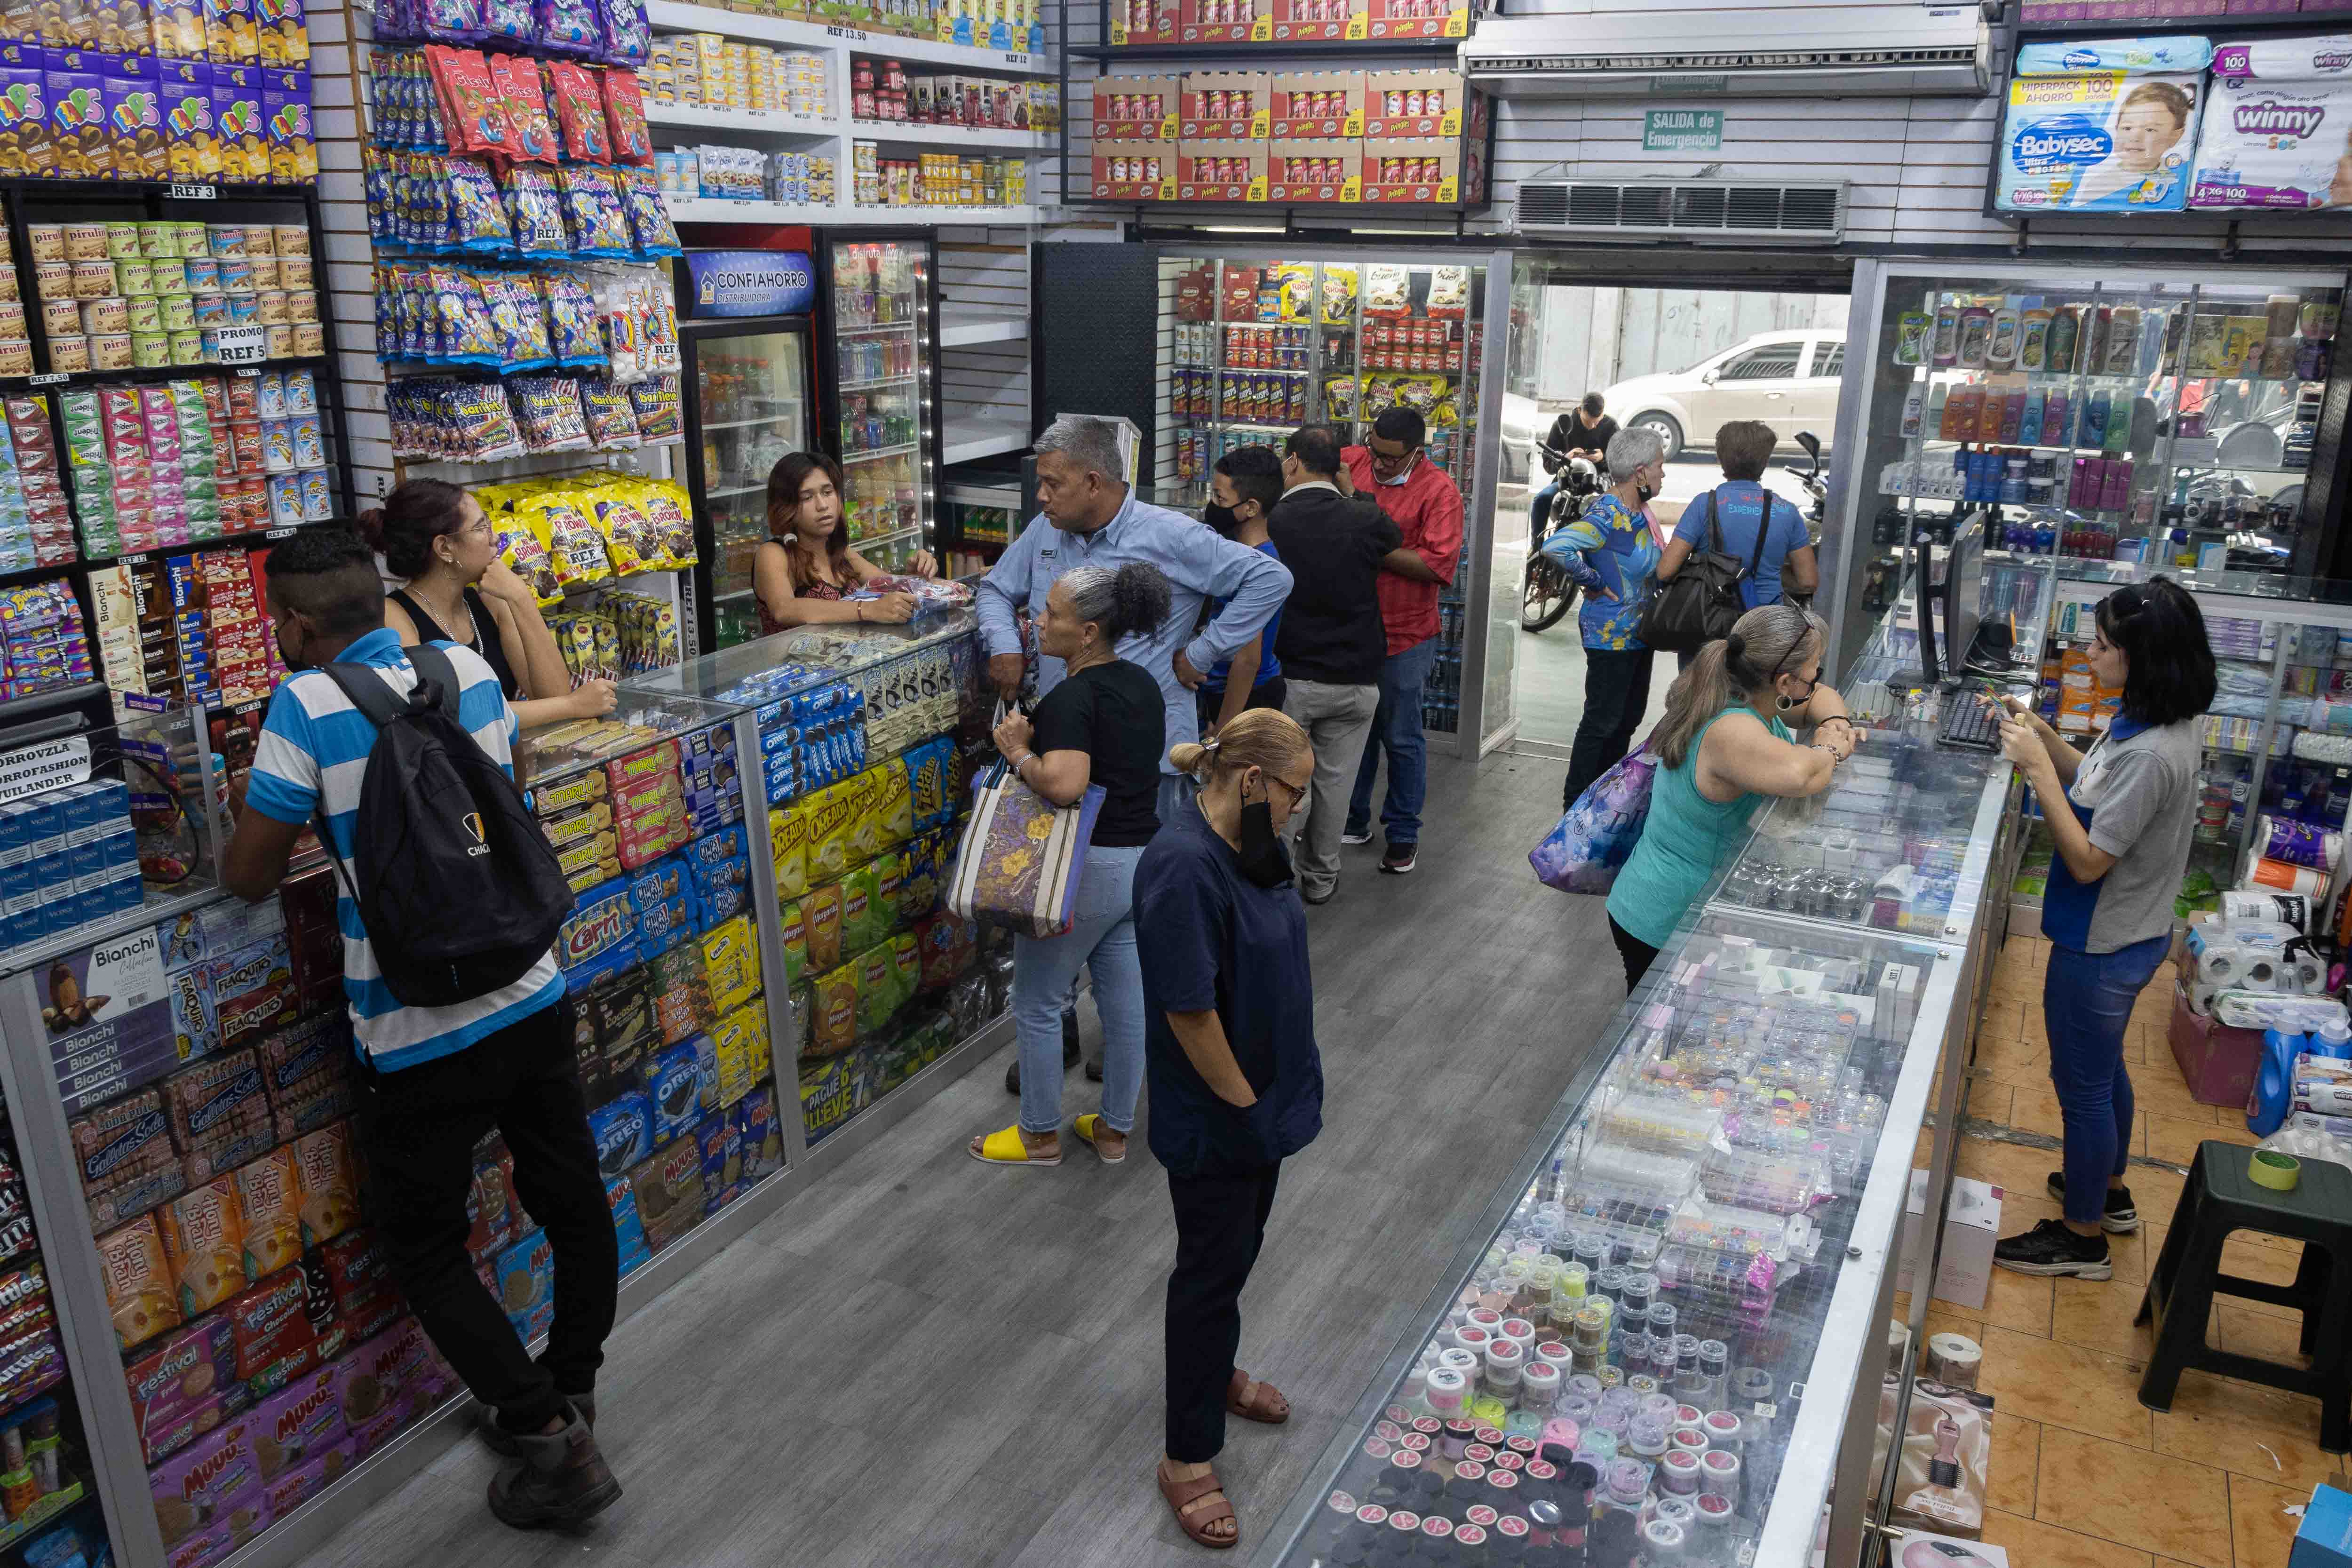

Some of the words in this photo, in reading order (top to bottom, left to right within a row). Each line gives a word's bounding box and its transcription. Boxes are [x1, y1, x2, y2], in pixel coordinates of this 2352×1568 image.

[827, 26, 843, 37] REF
[845, 29, 866, 41] 13.50
[1006, 54, 1018, 63] REF
[1020, 55, 1027, 64] 12
[2225, 56, 2246, 68] 100
[2022, 81, 2081, 92] HIPERPACK
[2086, 79, 2114, 94] 100
[2026, 92, 2074, 103] AHORRO
[386, 121, 396, 130] 50
[1653, 112, 1694, 128] SALIDA
[1700, 112, 1715, 128] de
[2237, 100, 2321, 136] winny
[1116, 122, 1134, 136] Pringles
[1204, 122, 1223, 136] Pringles
[1296, 121, 1315, 135] Pringles
[1390, 119, 1411, 135] Pringles
[1647, 132, 1717, 148] Emergencia
[2021, 135, 2106, 156] Babysec
[27, 142, 50, 155] CHOCOLATE
[87, 144, 110, 157] CHOCOLATE
[174, 187, 195, 197] REF
[205, 188, 214, 197] 3
[1116, 184, 1133, 198] Pringles
[1201, 184, 1220, 199] Pringles
[1293, 186, 1312, 199] Pringles
[1388, 185, 1407, 199] Pringles
[2198, 188, 2206, 198] 4
[2226, 189, 2247, 199] 100
[69, 228, 106, 241] pirulin
[537, 229, 554, 239] REF
[558, 229, 563, 238] 2
[852, 247, 881, 259] disfruta
[153, 264, 184, 276] pirulin
[717, 272, 808, 288] CONFIAHORRO
[717, 293, 771, 303] DISTRIBUIDORA
[221, 327, 263, 339] PROMO
[220, 346, 254, 361] REF
[258, 345, 264, 358] 5
[655, 345, 675, 354] REF
[175, 389, 199, 398] Trident
[110, 399, 134, 408] Trident
[180, 411, 203, 420] Trident
[113, 422, 136, 432] Trident
[613, 510, 642, 528] BROWN
[651, 509, 683, 525] BROWN
[515, 541, 545, 561] BROWN
[132, 574, 146, 616] Bianchi
[172, 567, 185, 607] Bianchi
[97, 581, 109, 623] Bianchi
[684, 587, 693, 614] REF
[104, 635, 124, 645] Bianchi
[142, 629, 161, 638] Bianchi
[108, 655, 128, 666] Bianchi
[111, 676, 131, 686] Bianchi
[237, 705, 250, 713] REF
[813, 696, 833, 710] OREO
[760, 707, 781, 722] OREO
[225, 726, 251, 738] TORONTO
[767, 733, 787, 749] OREO
[624, 753, 664, 776] MARILU
[771, 754, 791, 769] OREO
[811, 745, 821, 777] OREO
[820, 741, 831, 772] OREO
[773, 767, 794, 784] OREO
[550, 780, 594, 806] MARILU
[773, 782, 795, 800] OREO
[554, 812, 598, 840] MARILU
[633, 805, 672, 832] MARILU
[560, 841, 603, 868] MARILU
[569, 869, 603, 893] MARILU
[846, 894, 868, 912] Margarita
[813, 905, 839, 923] Margarita
[569, 912, 620, 956] Capri
[95, 935, 155, 967] Bianchi
[828, 1008, 852, 1024] Margarita
[66, 1023, 115, 1053] Bianchi
[70, 1041, 118, 1071] Bianchi
[74, 1060, 122, 1090] Bianchi
[659, 1063, 699, 1101] OREO
[79, 1078, 127, 1108] Bianchi
[809, 1073, 840, 1110] PAGUE
[189, 1090, 235, 1129] Galletas
[235, 1071, 261, 1094] Soda
[809, 1085, 853, 1130] LLEVE
[87, 1135, 136, 1175] Galletas
[135, 1114, 165, 1142] Soda
[263, 1165, 282, 1210] Hony
[247, 1174, 267, 1219] Bran
[200, 1194, 222, 1241] Hony
[185, 1204, 206, 1250] Bran
[125, 1234, 149, 1281] Hony
[108, 1245, 131, 1291] Bran
[245, 1277, 302, 1329] Festival
[264, 1300, 302, 1333] Chocolate
[137, 1345, 198, 1400] Festival
